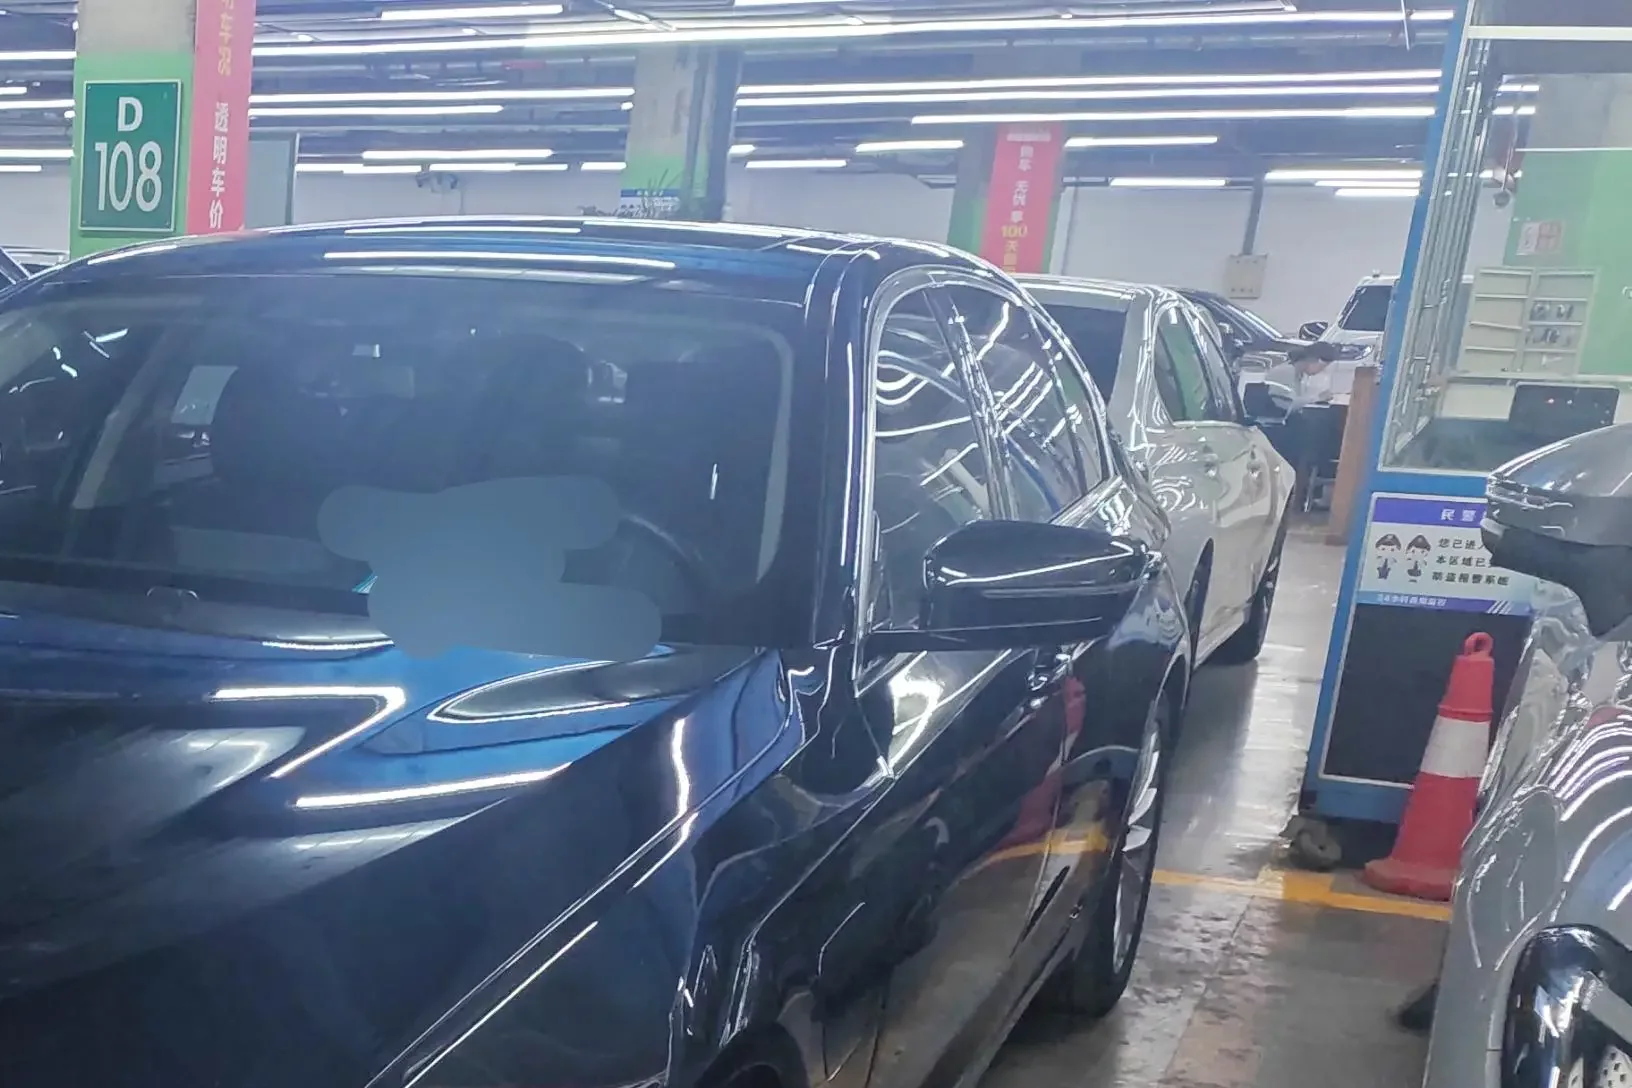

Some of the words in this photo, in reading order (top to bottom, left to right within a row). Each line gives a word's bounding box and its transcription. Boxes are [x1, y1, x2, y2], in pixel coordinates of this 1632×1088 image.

[117, 96, 144, 132] D
[95, 141, 162, 212] 108
[209, 102, 229, 228] 透明车价
